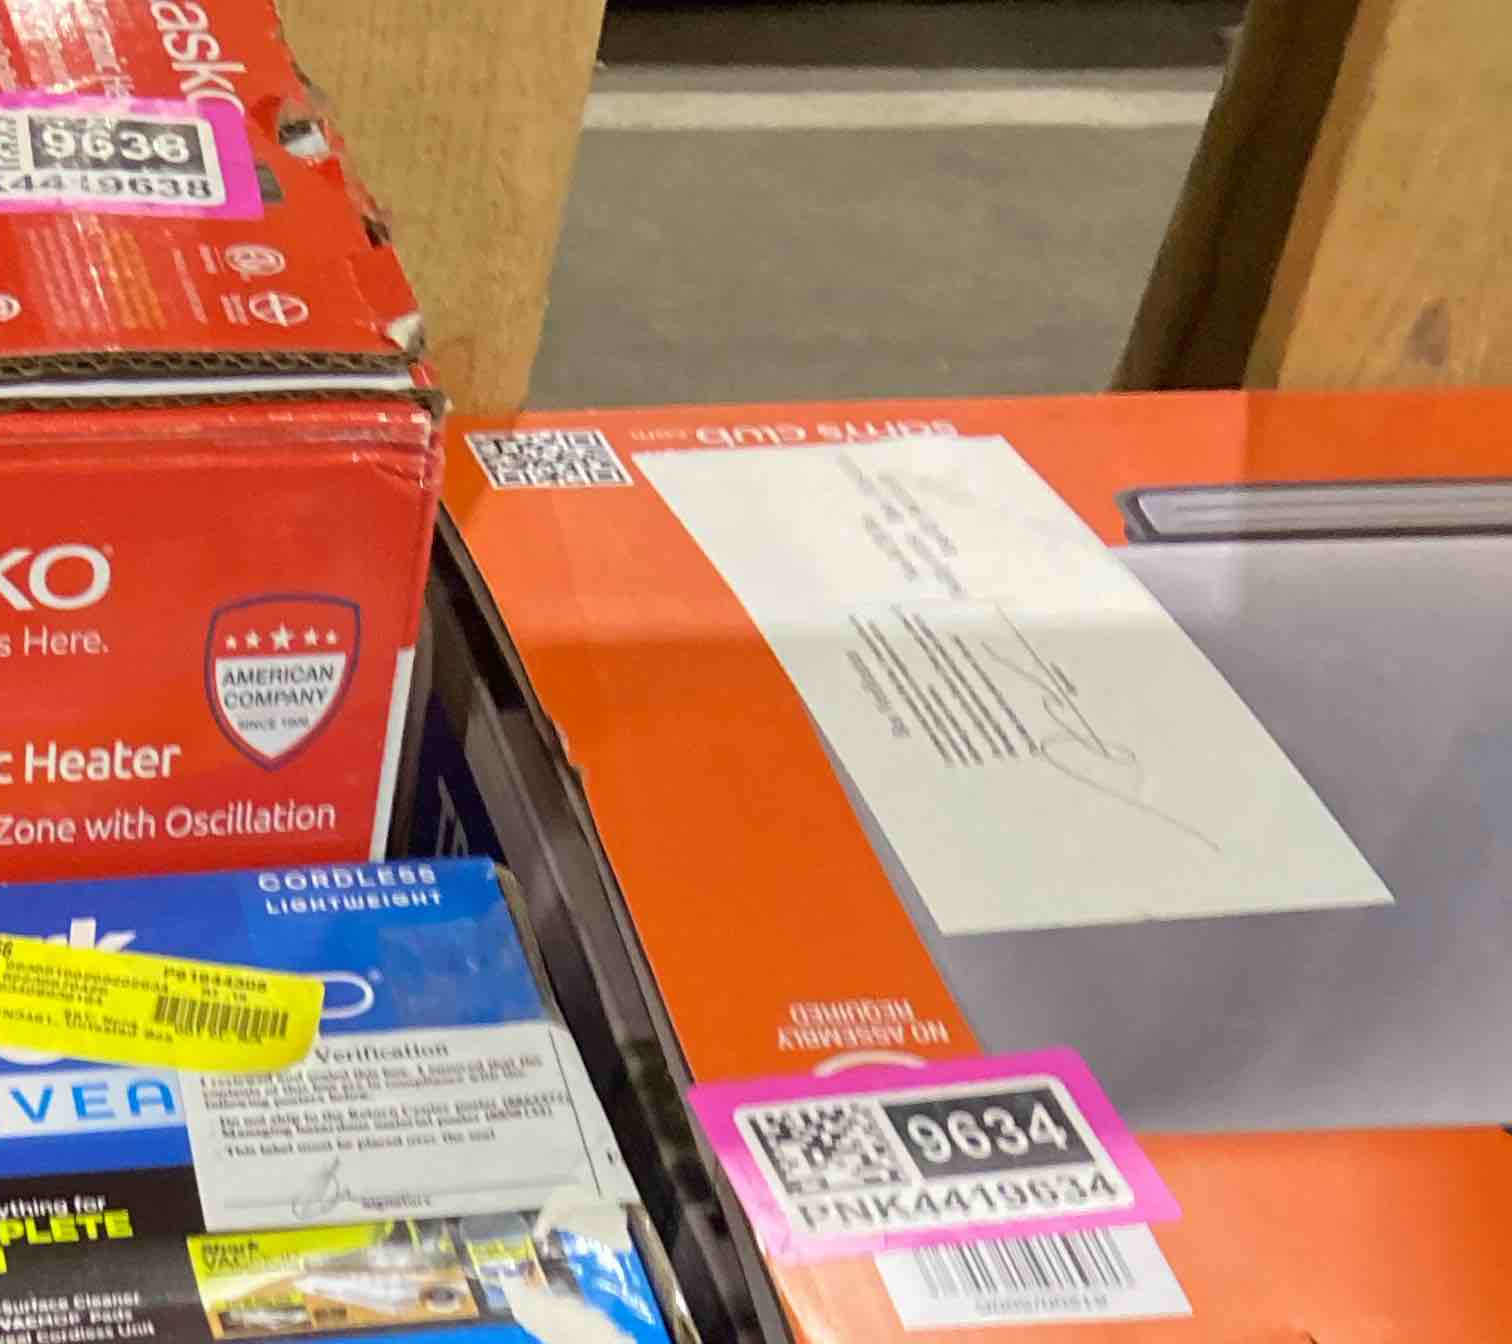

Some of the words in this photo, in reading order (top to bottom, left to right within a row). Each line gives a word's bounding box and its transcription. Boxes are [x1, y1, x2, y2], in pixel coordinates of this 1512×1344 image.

[151, 0, 246, 116] ask
[41, 125, 191, 164] 9638
[23, 623, 110, 657] Here.
[223, 664, 334, 686] AMERICAN
[223, 687, 329, 709] COMPANY
[24, 741, 181, 785] Heater
[85, 807, 157, 842] with
[165, 801, 336, 838] Oscillation
[258, 863, 437, 894] CORDLESS
[266, 890, 442, 916] LIGHTWEIGHT
[906, 1102, 1070, 1166] 9634
[73, 1194, 107, 1213] for
[799, 1170, 1118, 1234] PNK4419634
